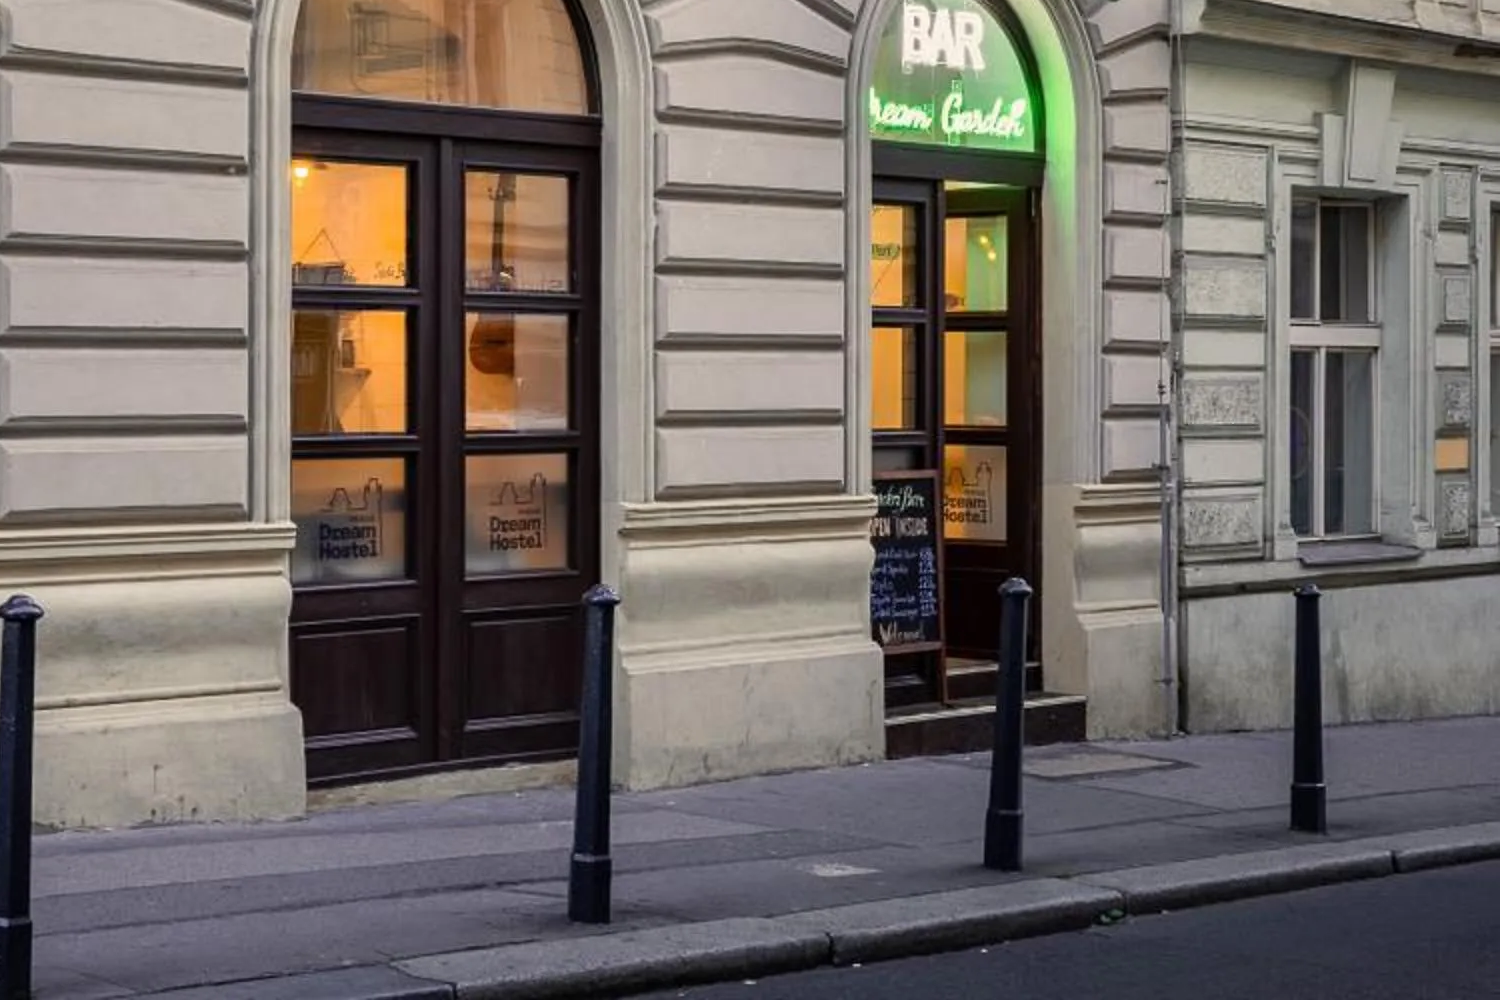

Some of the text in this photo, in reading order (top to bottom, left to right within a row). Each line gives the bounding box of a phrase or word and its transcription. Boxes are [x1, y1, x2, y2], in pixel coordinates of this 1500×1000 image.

[902, 4, 985, 70] BAR
[319, 523, 377, 541] Dream
[490, 517, 541, 533] Dream
[319, 540, 378, 561] Hostel
[490, 532, 543, 551] Hostel
